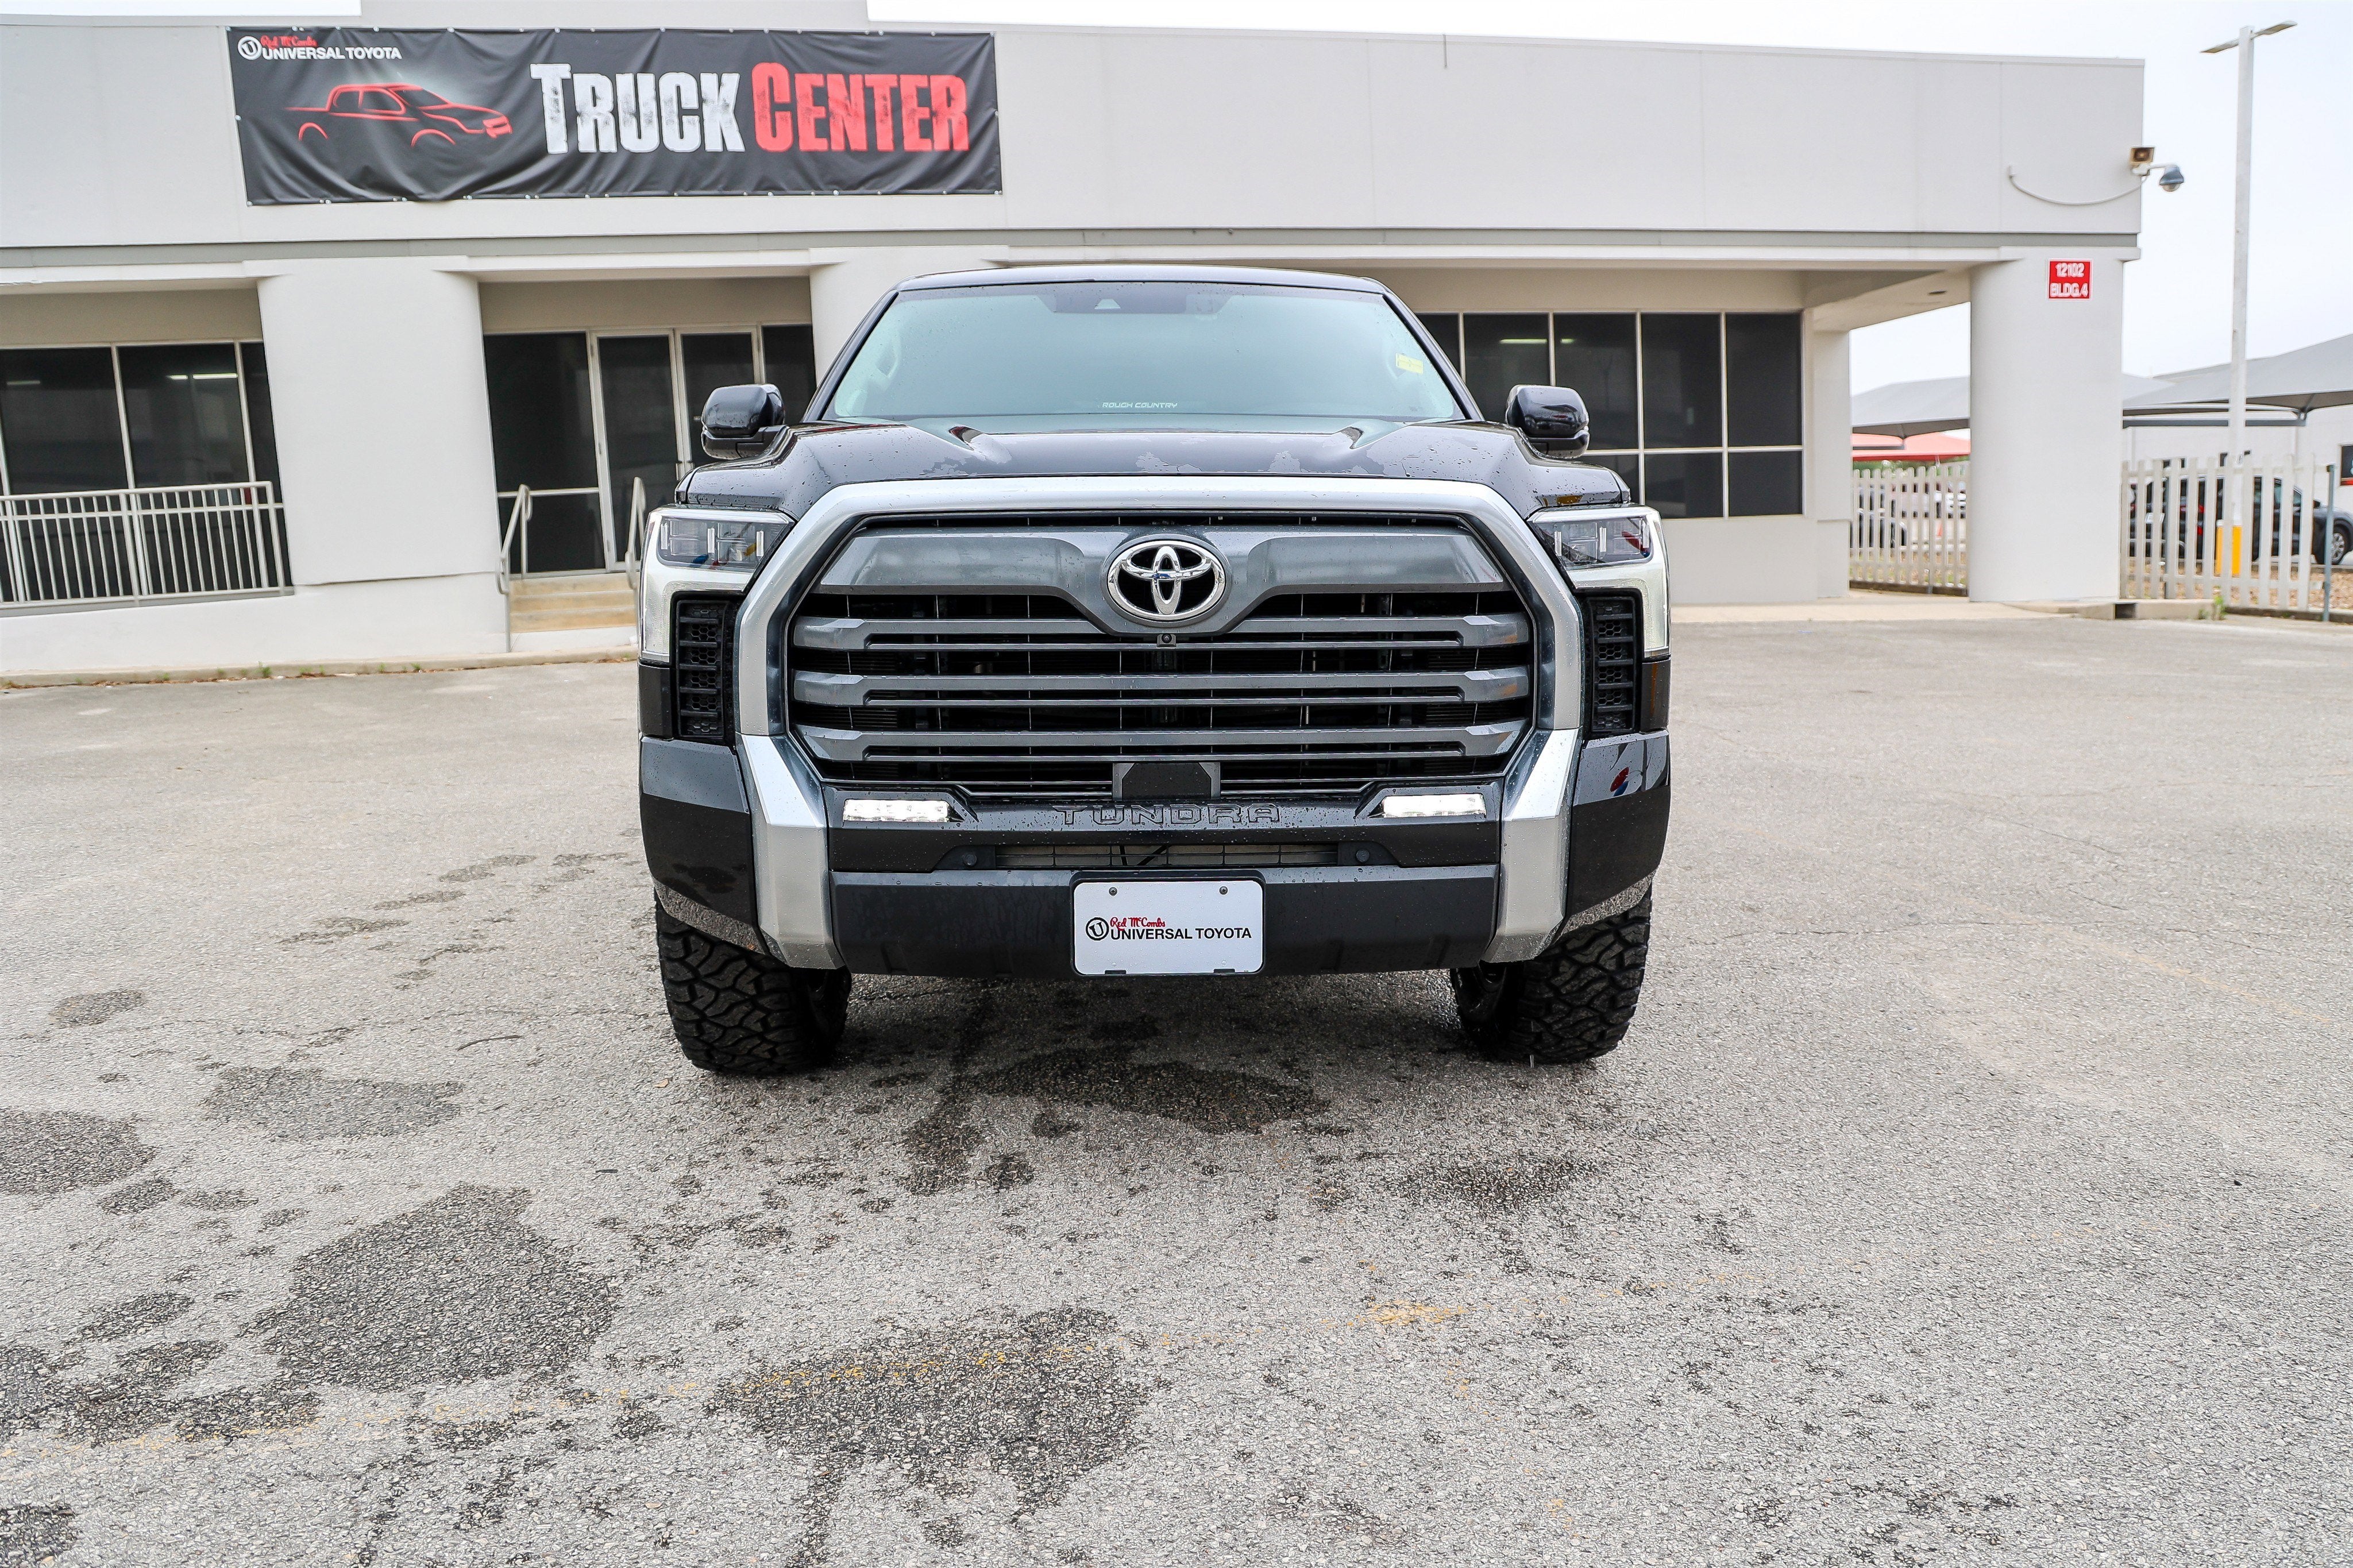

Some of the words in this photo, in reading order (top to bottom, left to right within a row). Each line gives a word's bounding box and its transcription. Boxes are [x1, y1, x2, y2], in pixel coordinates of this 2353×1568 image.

[262, 47, 345, 60] UNIVERSAL
[345, 47, 402, 60] TOYOTA
[530, 63, 746, 155] TRUCK
[751, 62, 969, 152] CENTER
[2055, 262, 2085, 277] 12102
[2050, 282, 2080, 298] BLDG
[2080, 283, 2088, 297] 4
[1052, 804, 1280, 825] TUNDRA
[1110, 917, 1127, 931] Red
[1111, 928, 1193, 940] UNIVERSAL
[1195, 928, 1252, 939] TOYOTA
